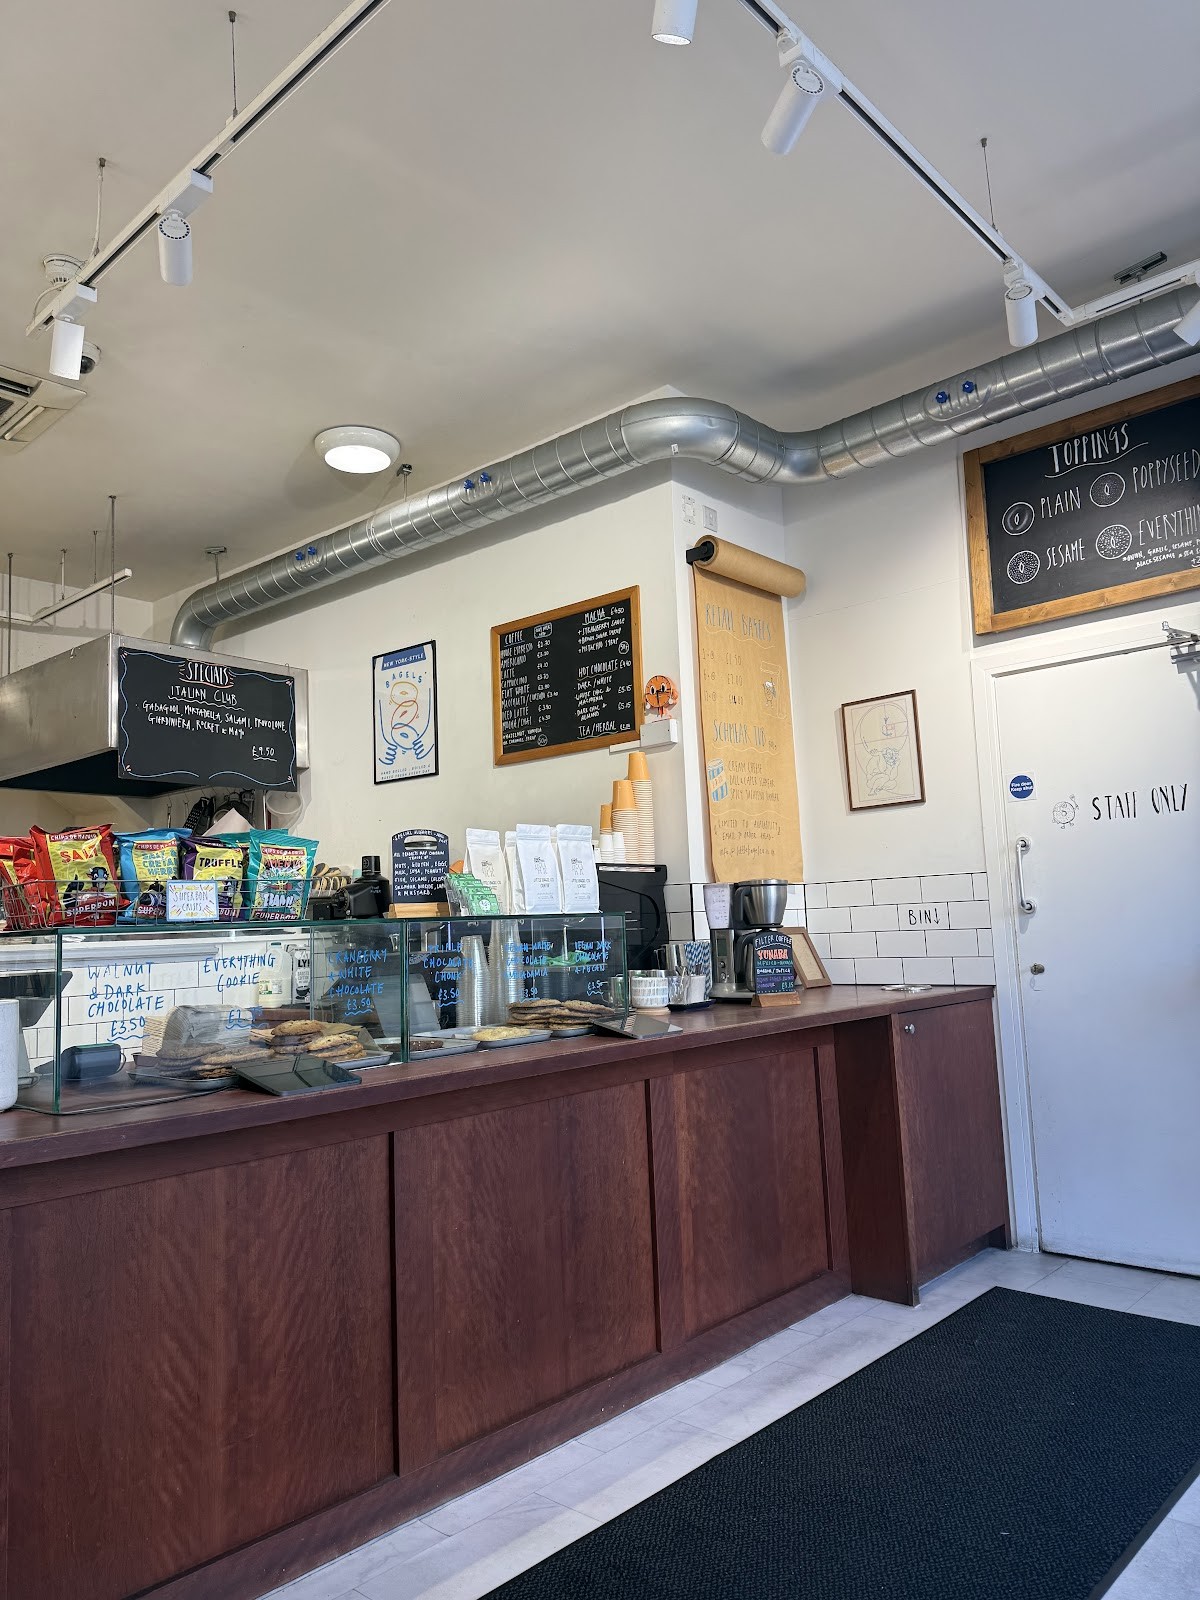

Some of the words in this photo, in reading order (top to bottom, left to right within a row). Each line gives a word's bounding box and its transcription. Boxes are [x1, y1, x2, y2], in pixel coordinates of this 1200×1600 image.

[1048, 423, 1129, 474] TOPPINGS
[1040, 487, 1081, 519] PLAIN
[1046, 538, 1085, 570] SESAME
[504, 630, 523, 645] COFFEE
[186, 661, 229, 686] SPECIALS
[385, 671, 423, 689] BAGELS
[578, 665, 589, 678] HOT
[214, 689, 238, 706] CLUB
[195, 720, 220, 734] ROCKET
[224, 713, 253, 730] SALAMI,
[251, 745, 275, 758] £9.50
[1151, 783, 1187, 814] ONLY
[199, 857, 243, 869] TRUFFLE
[66, 898, 115, 917] SUPERBON
[137, 905, 166, 917] SUPER
[908, 908, 932, 926] BIN
[754, 934, 774, 948] FILTER
[202, 953, 276, 975] EVERYTHING
[327, 949, 388, 965] CRANBERRY
[87, 960, 155, 981] WALNUT
[337, 965, 373, 979] WHITE
[104, 983, 146, 1001] DARK
[217, 972, 260, 994] COOKIE
[329, 982, 385, 999] CHOCOLATE
[87, 994, 165, 1019] CHOCOLATE
[346, 998, 372, 1011] £3.50
[109, 1016, 146, 1037] £3.50
